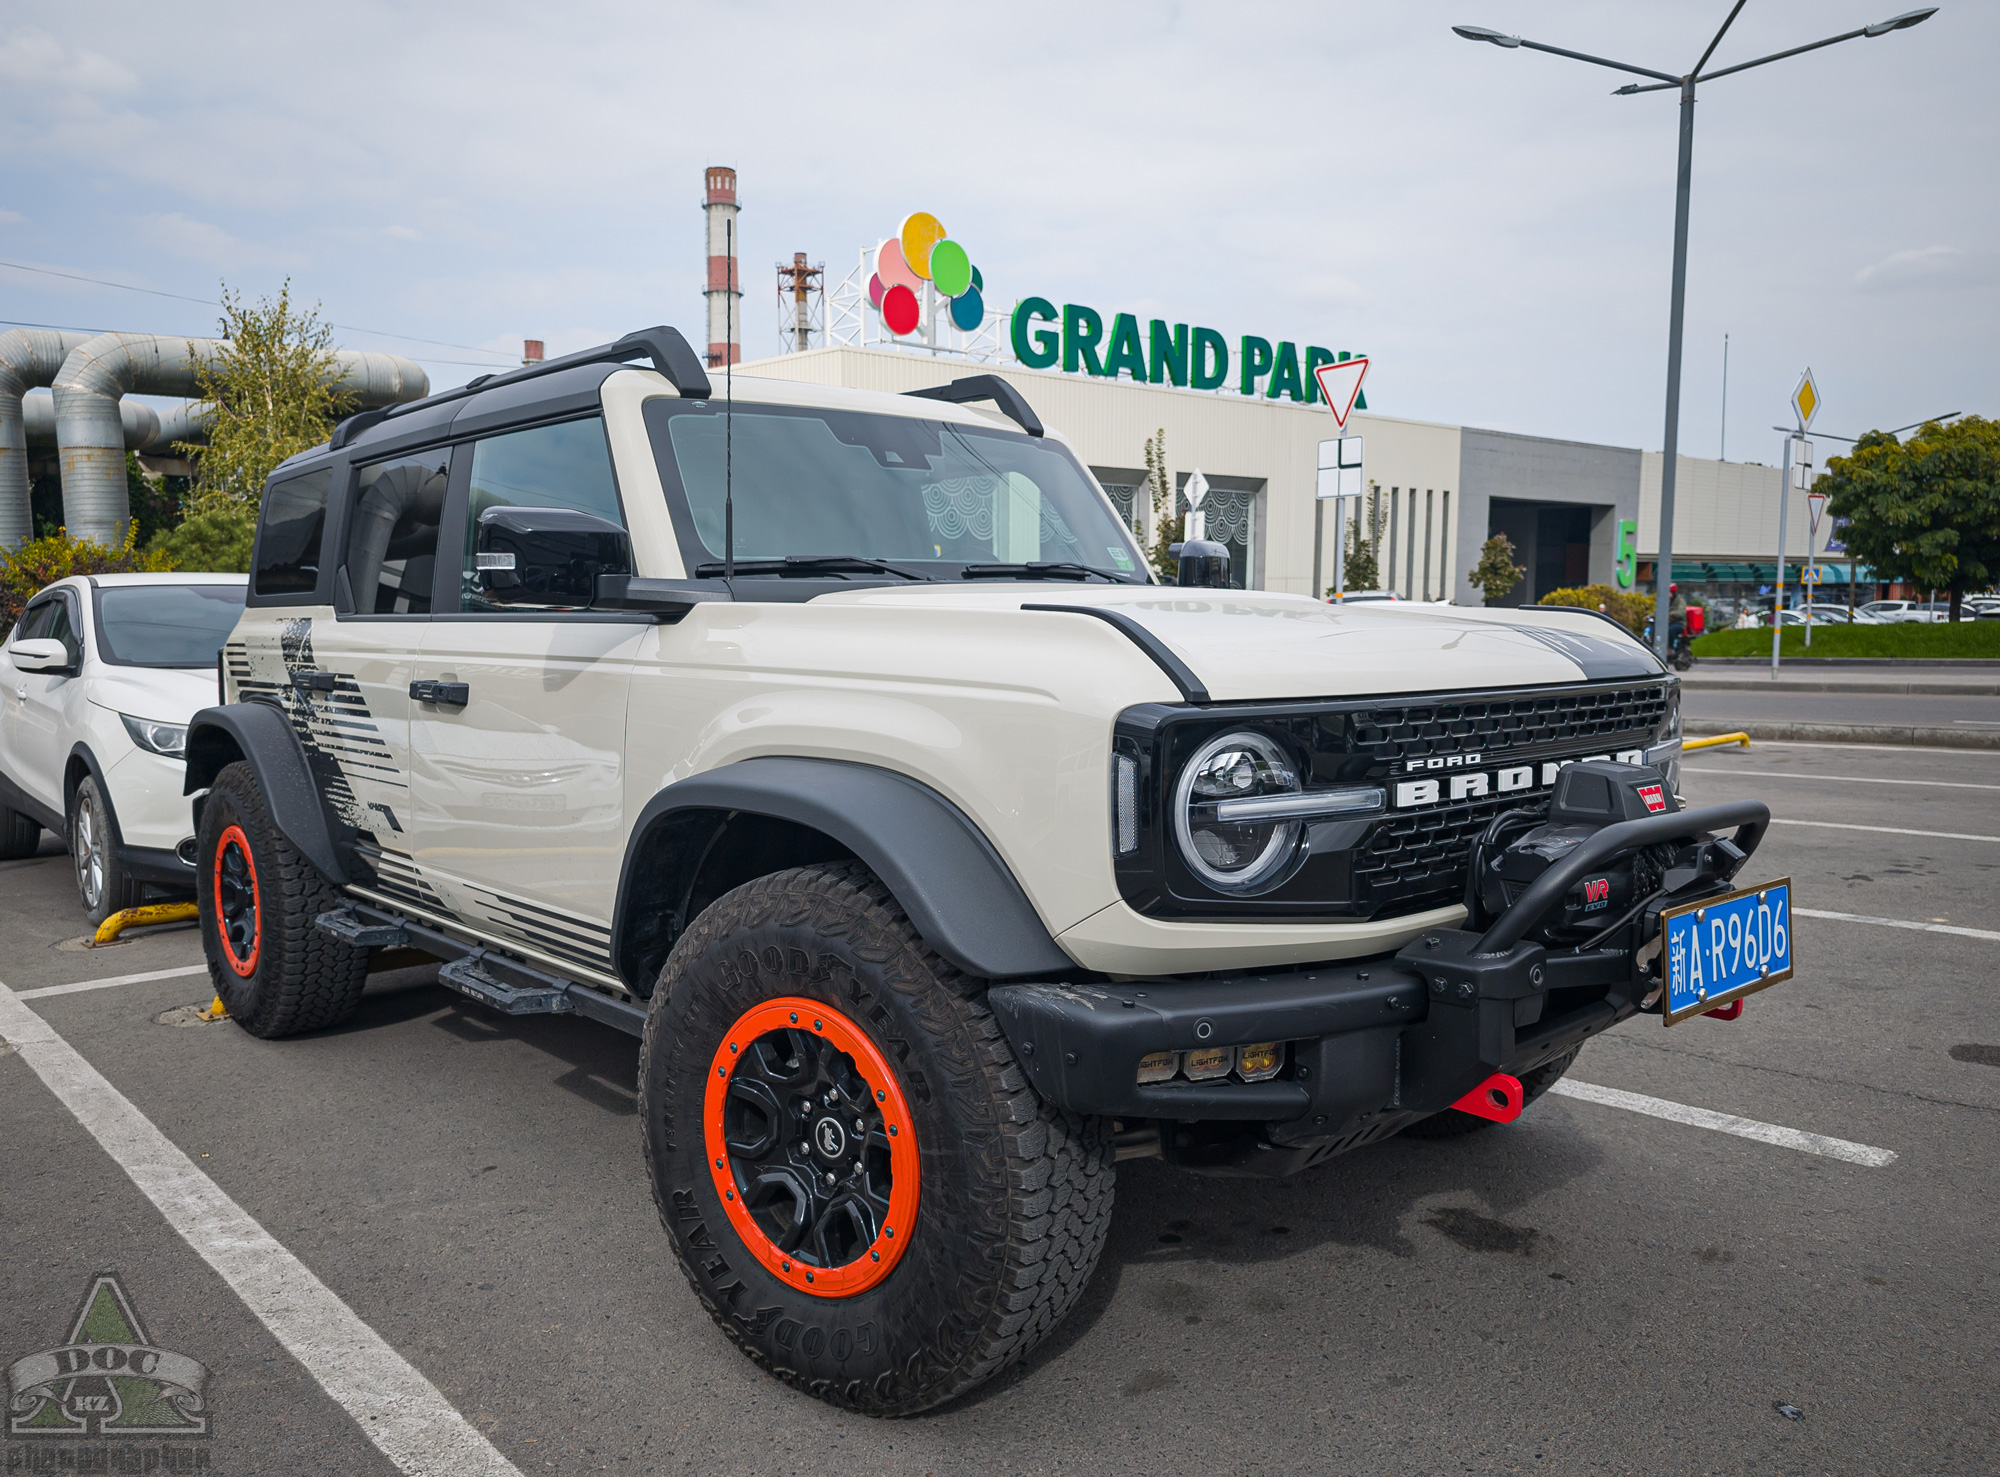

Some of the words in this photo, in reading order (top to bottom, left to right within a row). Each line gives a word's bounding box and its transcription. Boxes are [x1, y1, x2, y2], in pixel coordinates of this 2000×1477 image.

[1011, 297, 1229, 390] GRAND
[1615, 519, 1637, 588] 5
[1396, 749, 1643, 808] BRONO
[1406, 753, 1482, 772] FORD
[1584, 878, 1609, 903] VR
